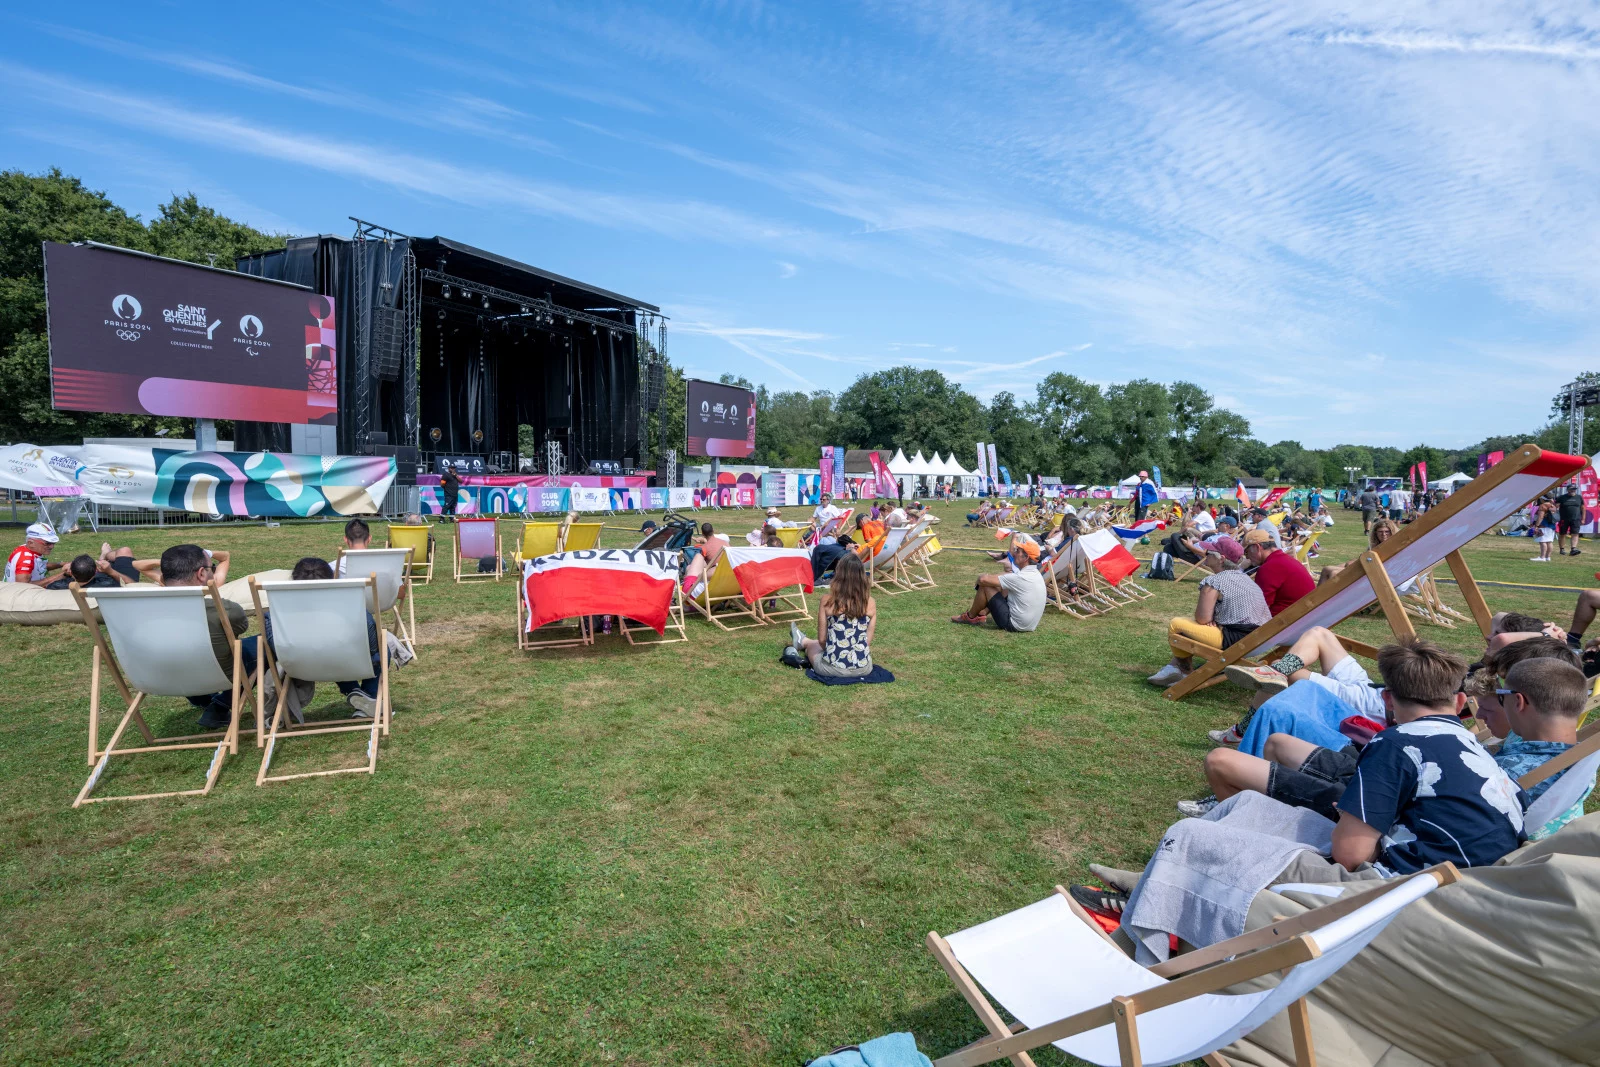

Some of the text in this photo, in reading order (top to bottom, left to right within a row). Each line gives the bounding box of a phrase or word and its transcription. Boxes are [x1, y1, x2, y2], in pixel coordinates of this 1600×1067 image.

[178, 304, 206, 315] SAINT
[163, 309, 206, 322] QUENTIN
[104, 319, 151, 331] PARIS 2024
[175, 318, 207, 328] YVELINES
[233, 337, 252, 345] PARIS
[8, 458, 24, 466] PARIS
[51, 456, 78, 465] QUENTIN
[100, 478, 121, 486] PARIS
